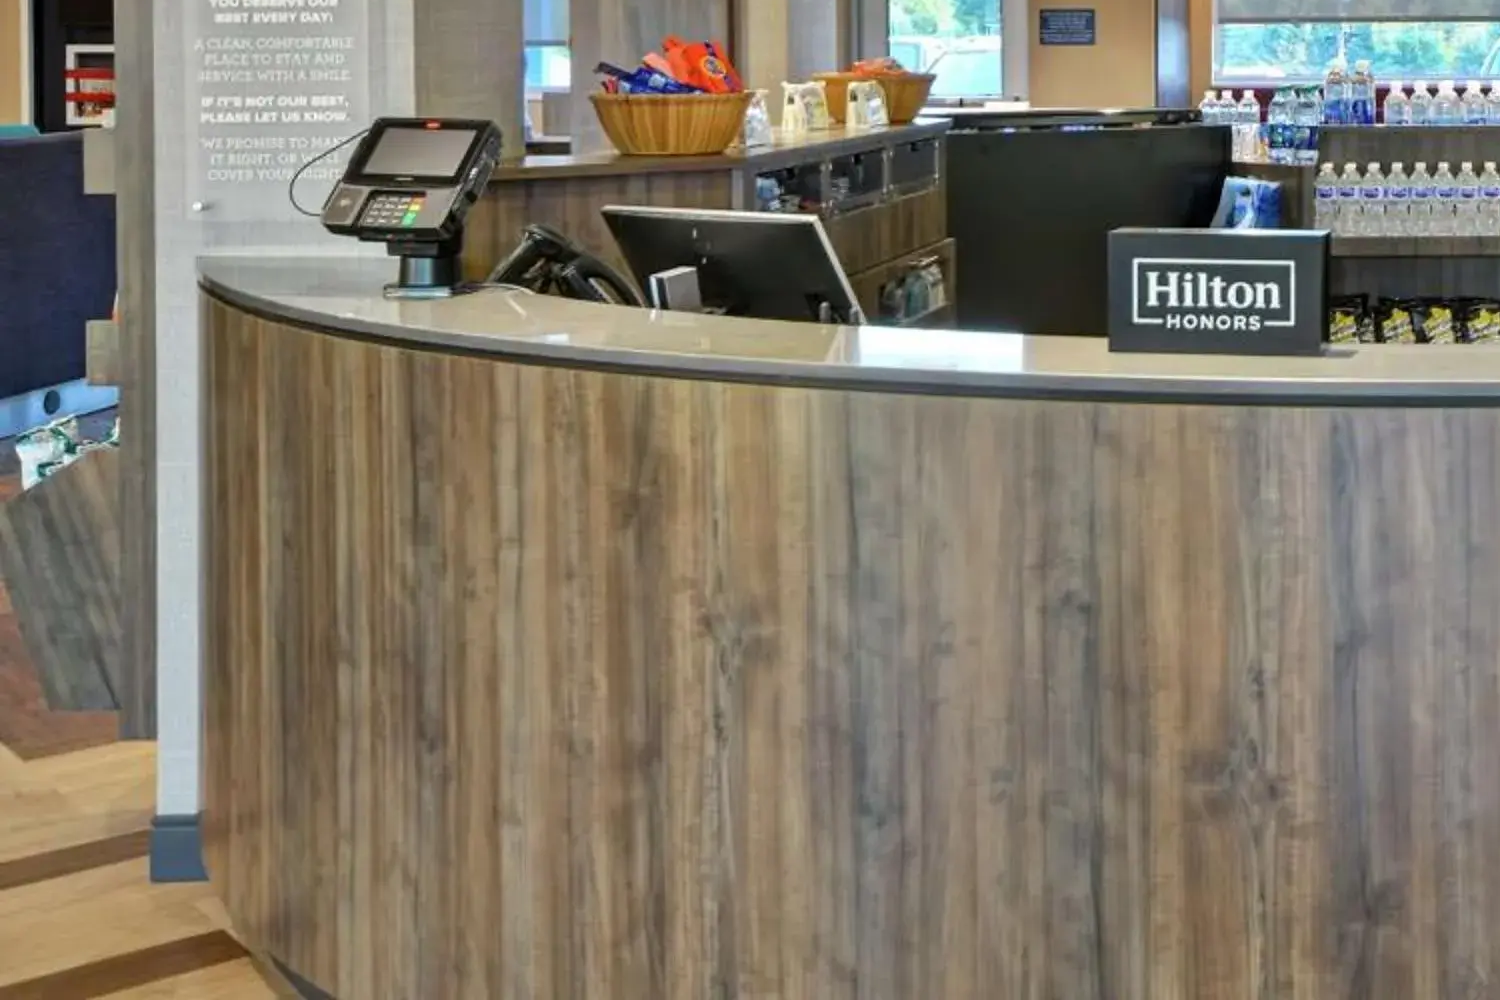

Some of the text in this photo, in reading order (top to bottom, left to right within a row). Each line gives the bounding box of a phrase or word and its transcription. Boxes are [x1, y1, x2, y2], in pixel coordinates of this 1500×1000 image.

[252, 12, 297, 24] EVERY
[204, 52, 346, 66] PLACE TO STAY AND
[245, 96, 274, 107] NOT
[276, 95, 308, 107] OUR
[201, 111, 251, 124] PLEASE
[254, 111, 279, 123] LET
[281, 111, 301, 123] US
[288, 137, 309, 150] TO
[1145, 271, 1281, 310] Hilton
[1166, 313, 1262, 332] HONORS
